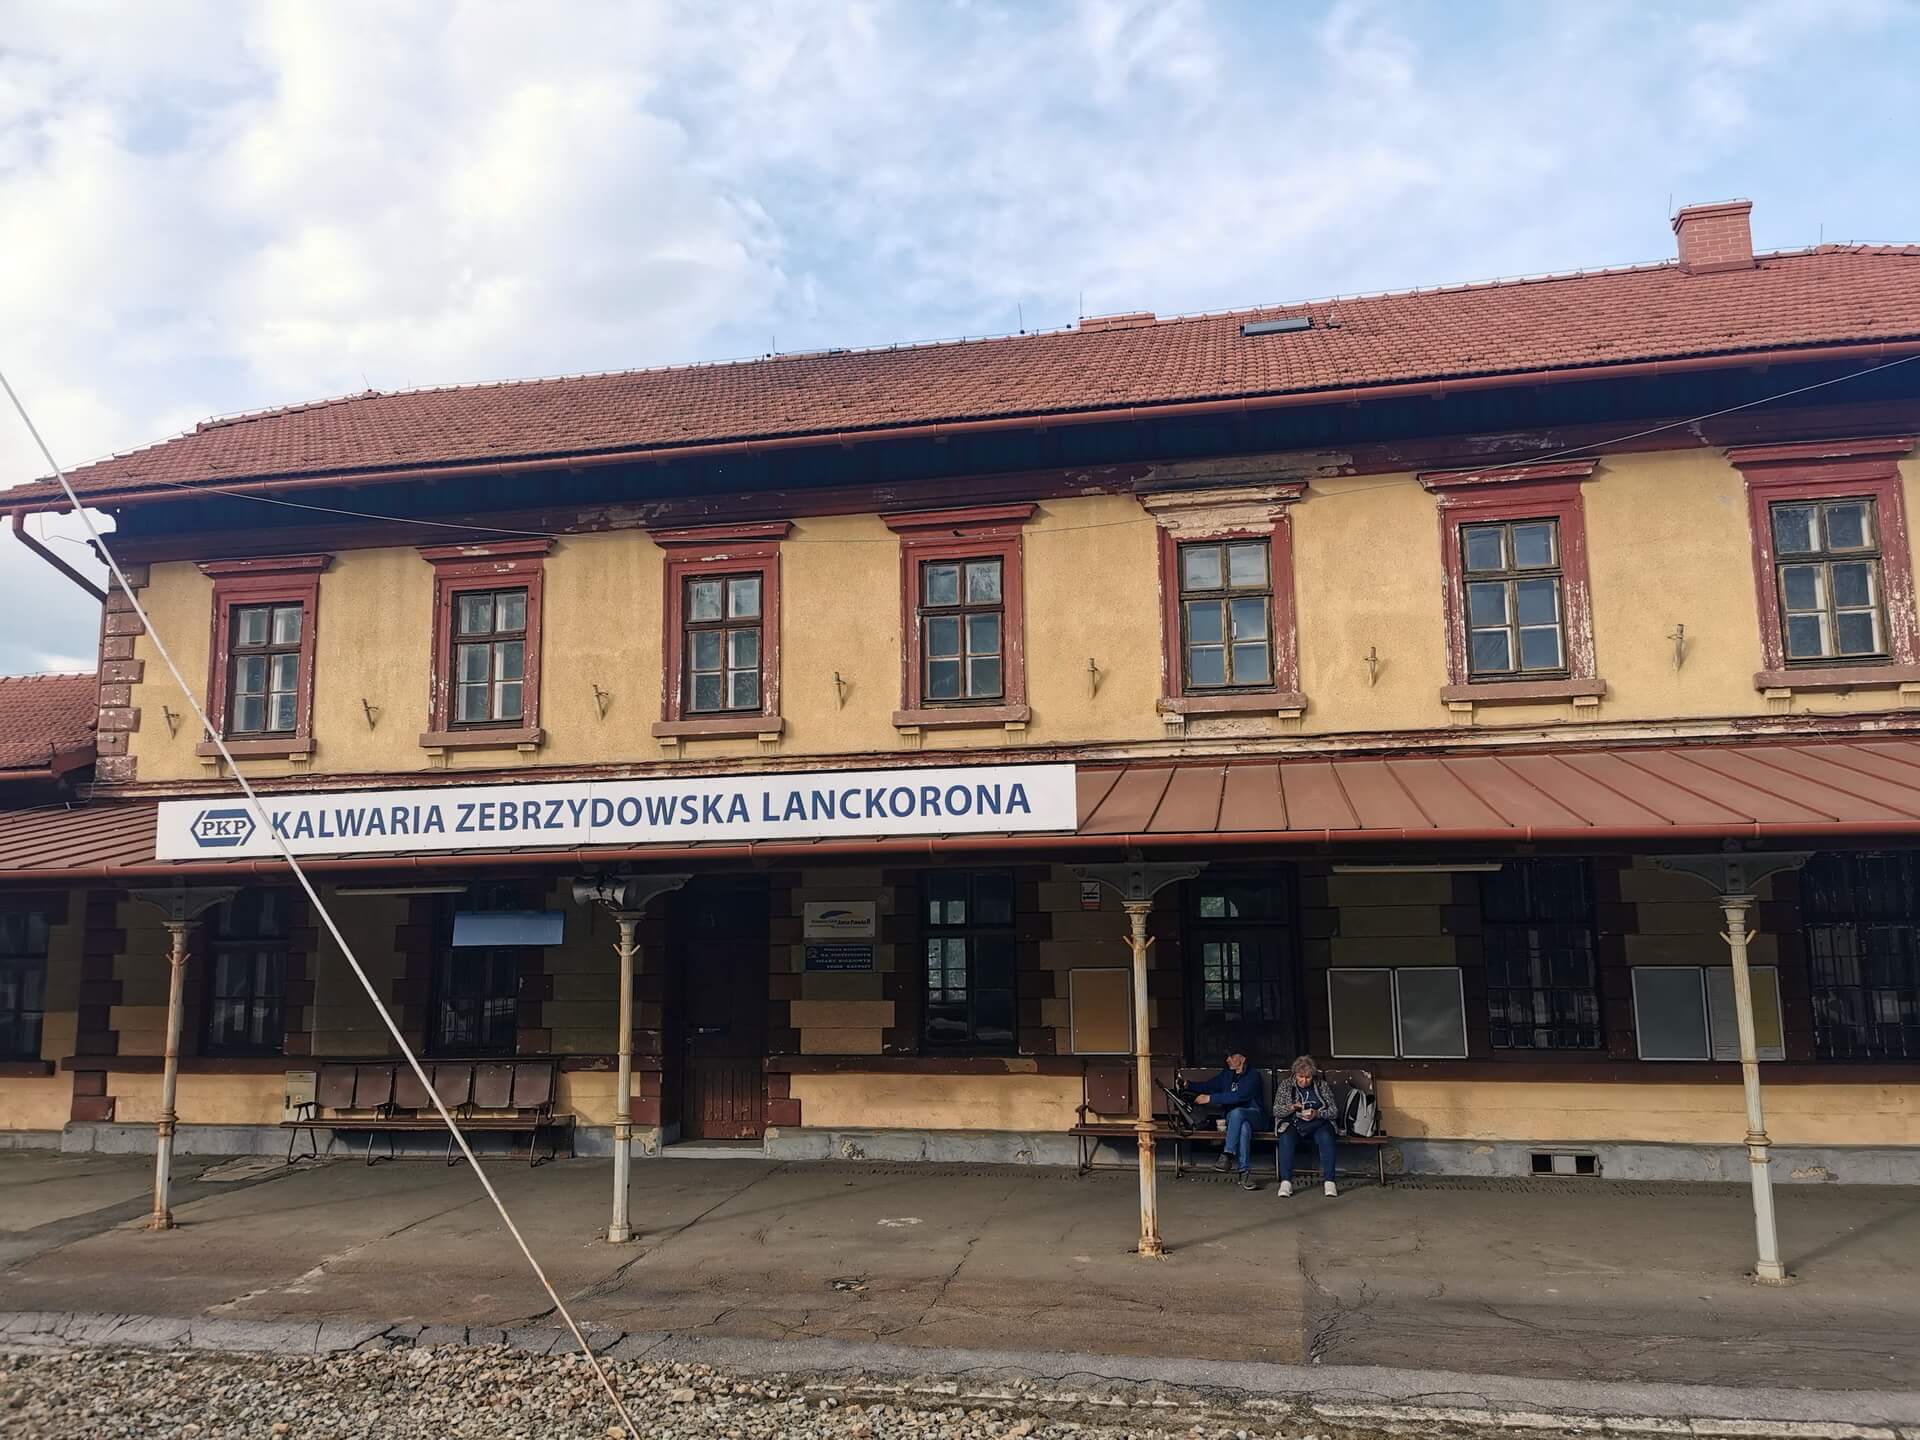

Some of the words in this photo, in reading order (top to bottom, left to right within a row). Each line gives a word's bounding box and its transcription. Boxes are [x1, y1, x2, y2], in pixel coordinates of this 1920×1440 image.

[201, 820, 247, 836] PKP
[271, 804, 446, 840] KALWARIA
[455, 793, 750, 832] ZEBRZYDOWSKA
[762, 783, 1032, 822] LANCKORONA
